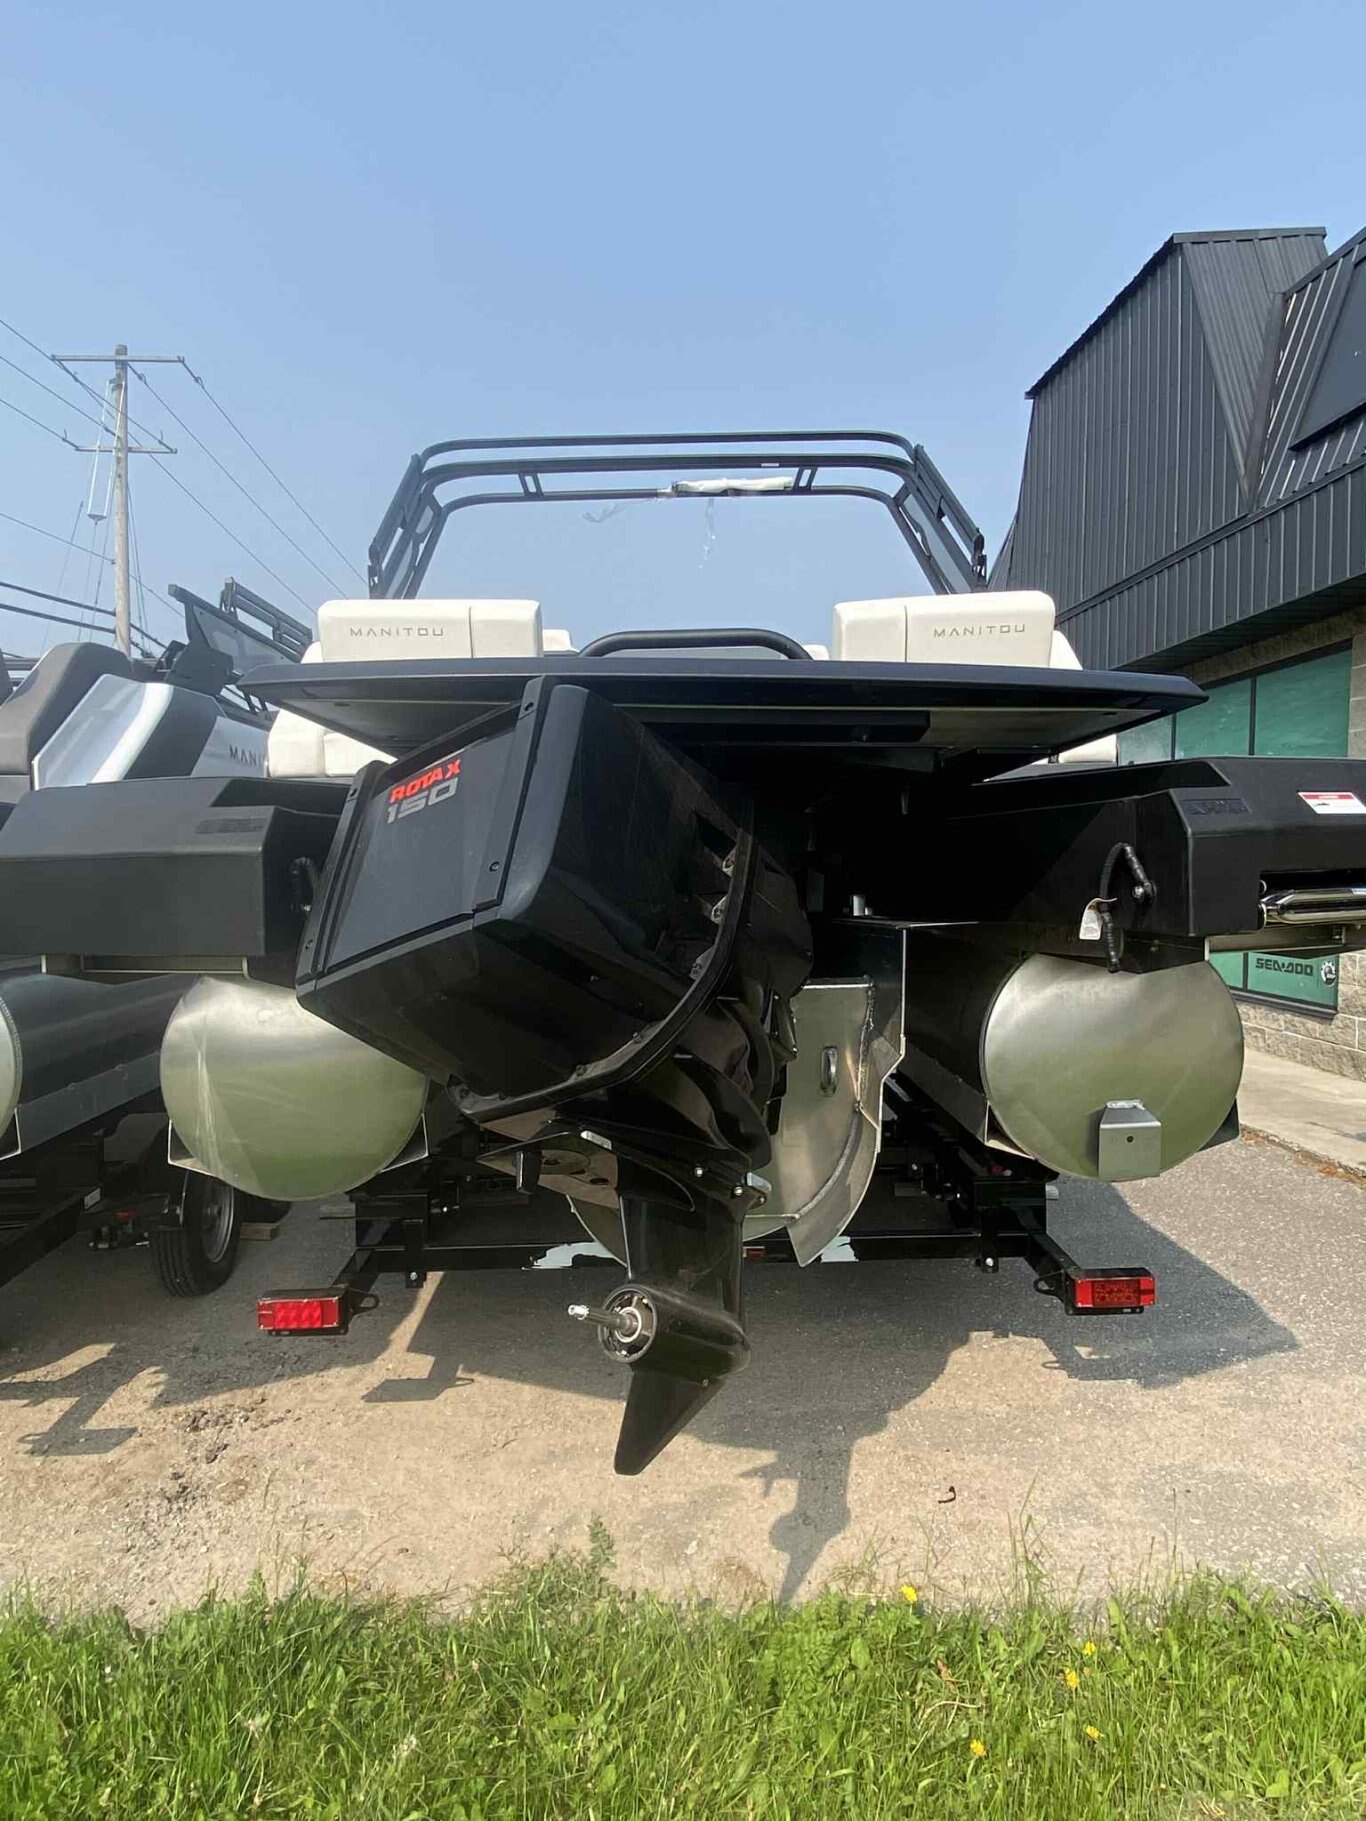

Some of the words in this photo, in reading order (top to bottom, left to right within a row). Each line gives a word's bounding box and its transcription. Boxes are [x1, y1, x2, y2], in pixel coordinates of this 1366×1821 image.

[349, 626, 444, 637] MANITOU
[933, 623, 1026, 638] MANITOU
[229, 743, 264, 767] MANI
[389, 757, 461, 803] ROTAX
[386, 777, 459, 824] 150
